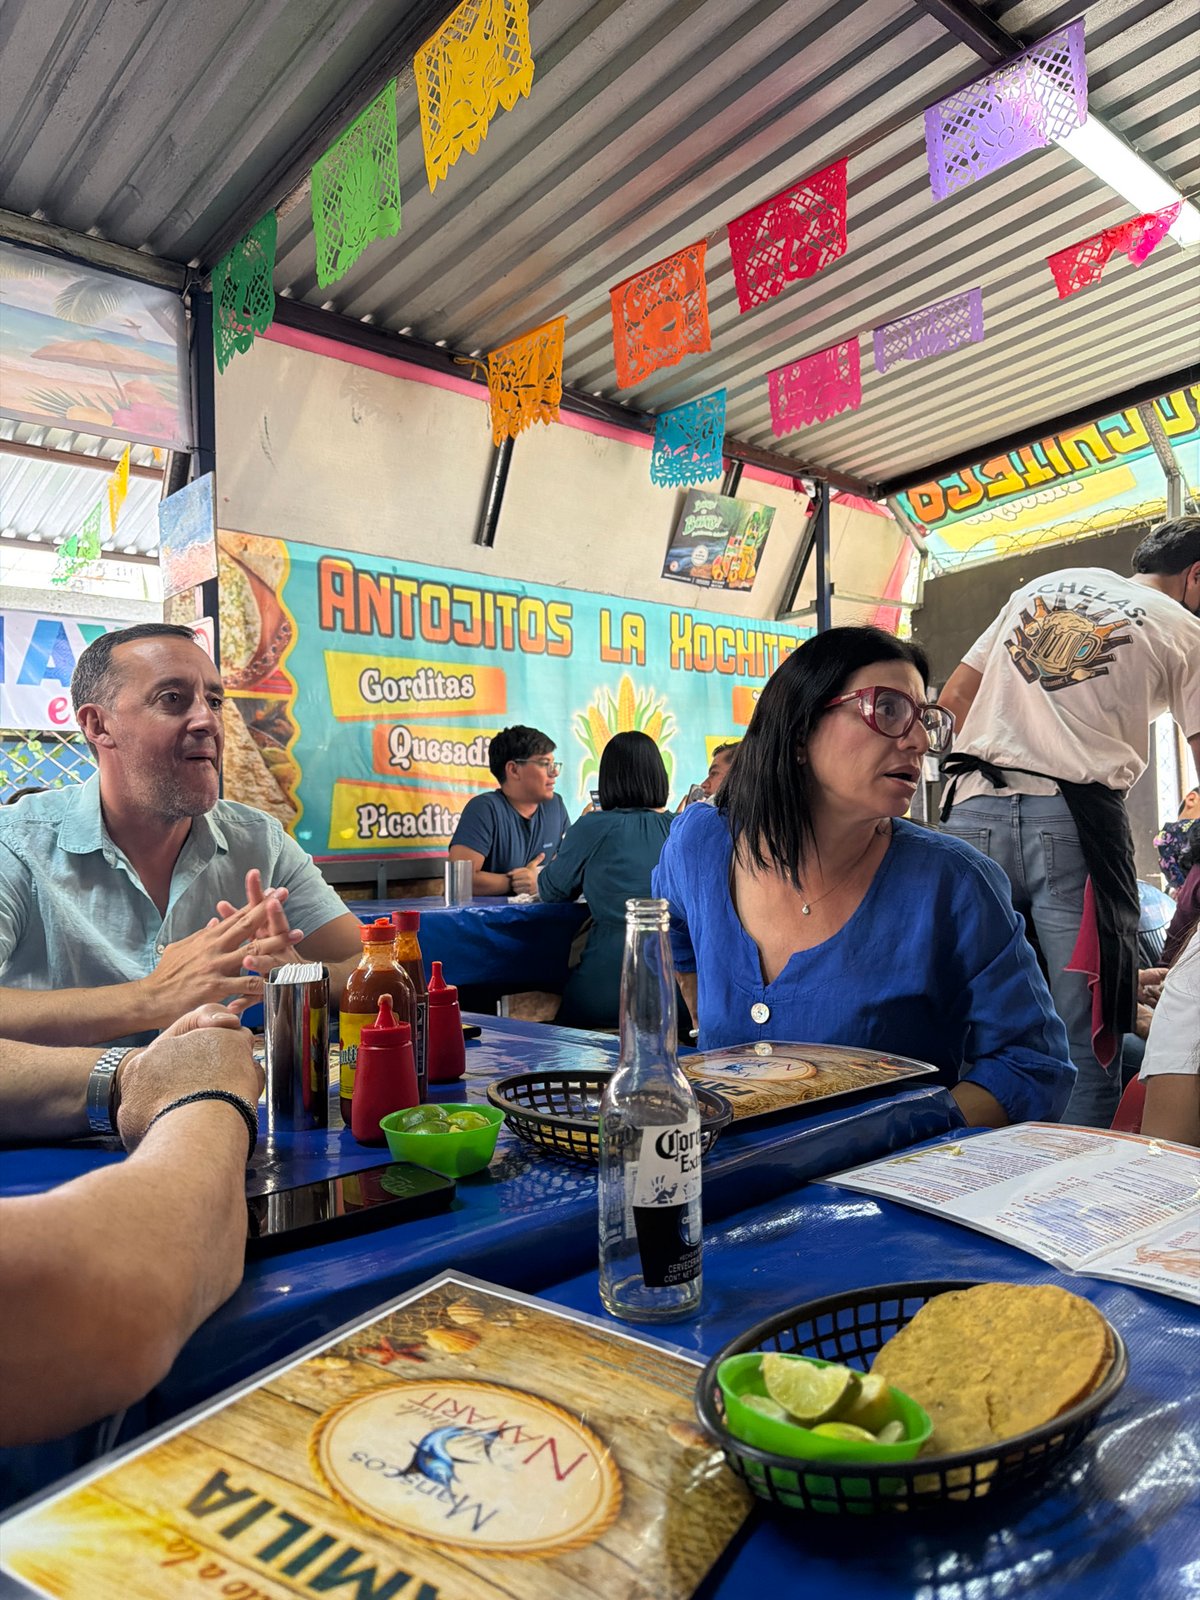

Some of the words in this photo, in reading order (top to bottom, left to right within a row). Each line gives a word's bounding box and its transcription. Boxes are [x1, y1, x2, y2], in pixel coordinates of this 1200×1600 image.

[317, 555, 573, 657] ANTOJITOS
[600, 608, 647, 667] LA
[670, 611, 808, 679] XOCHITE
[360, 668, 475, 703] Gorditas
[388, 725, 491, 771] Quesadi
[407, 1392, 589, 1481] NAYARIT
[185, 1467, 440, 1600] MILIA
[348, 1450, 499, 1533] Mariscos
